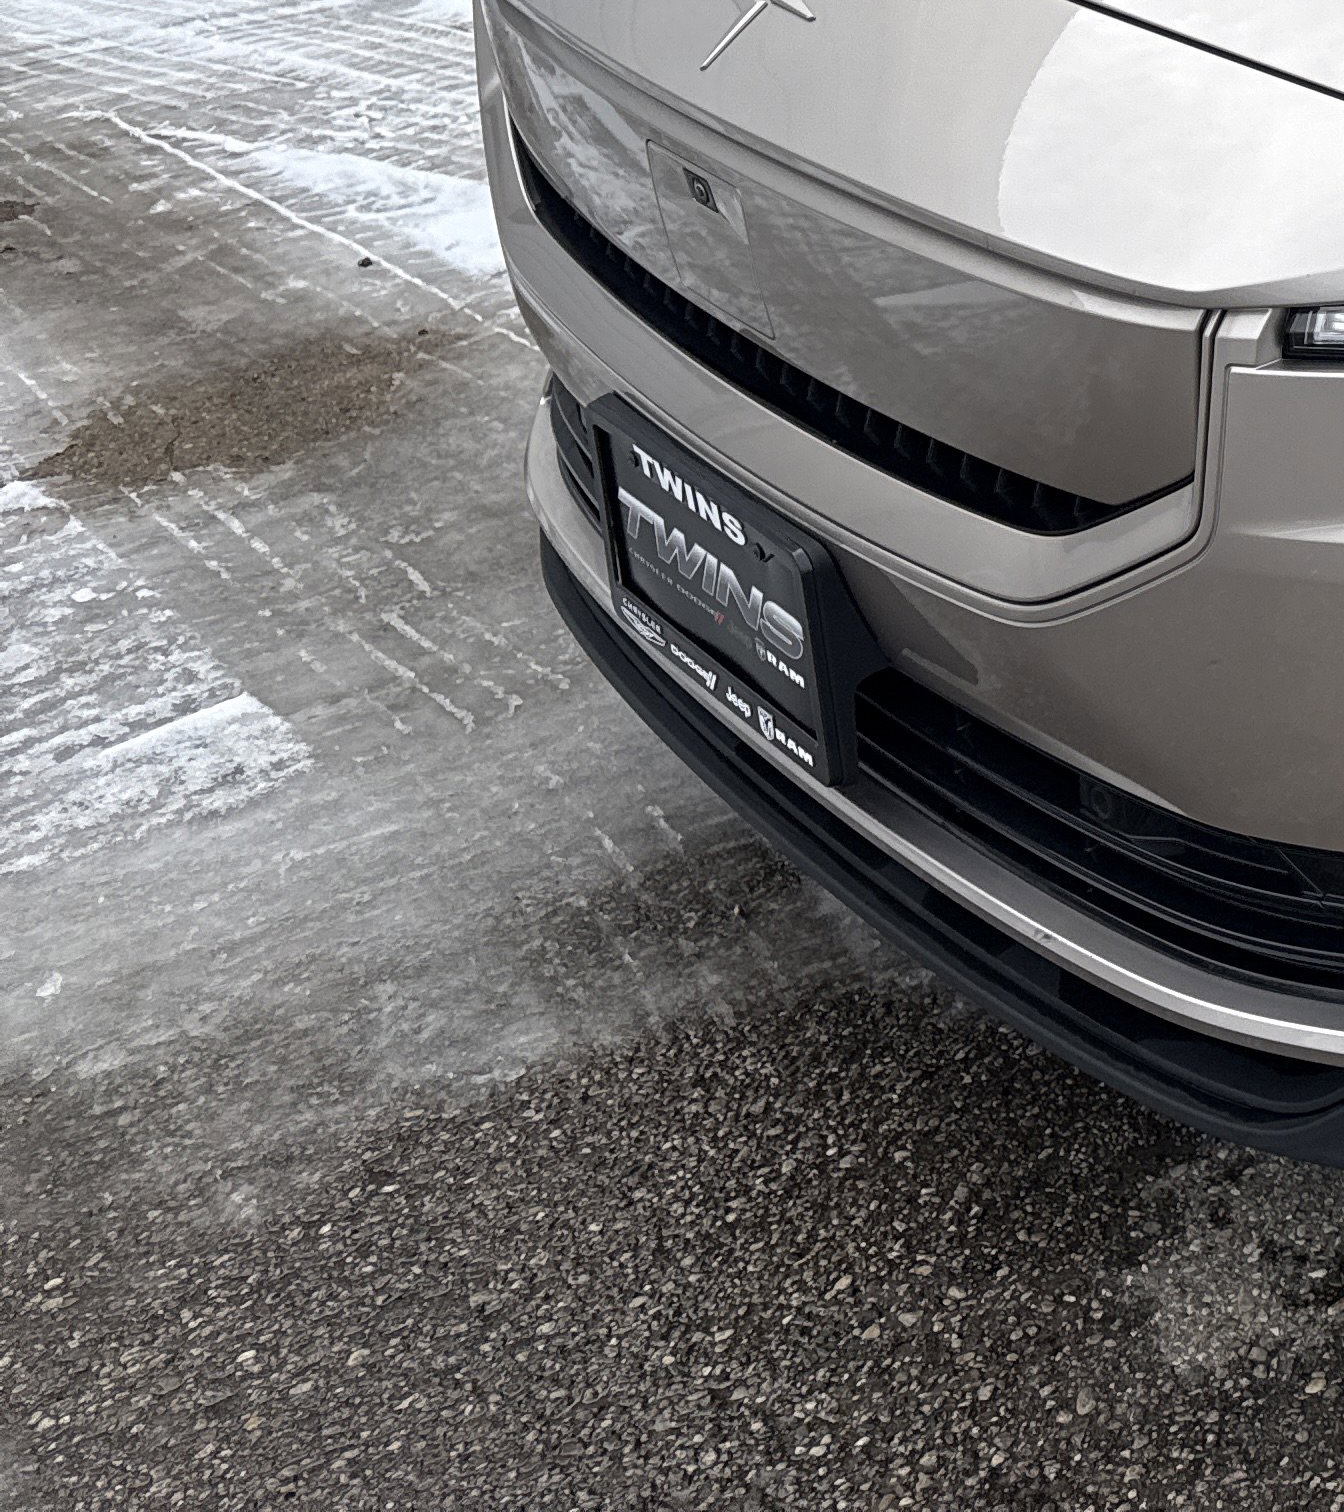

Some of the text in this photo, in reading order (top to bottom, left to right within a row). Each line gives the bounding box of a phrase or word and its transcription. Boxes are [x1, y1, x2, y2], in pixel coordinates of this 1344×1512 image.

[632, 443, 746, 547] TWINS
[617, 486, 804, 660] TWINS
[622, 597, 662, 634] CHRYSLER
[766, 649, 805, 689] RAM
[725, 686, 751, 718] Jeep
[774, 728, 814, 767] RAM
